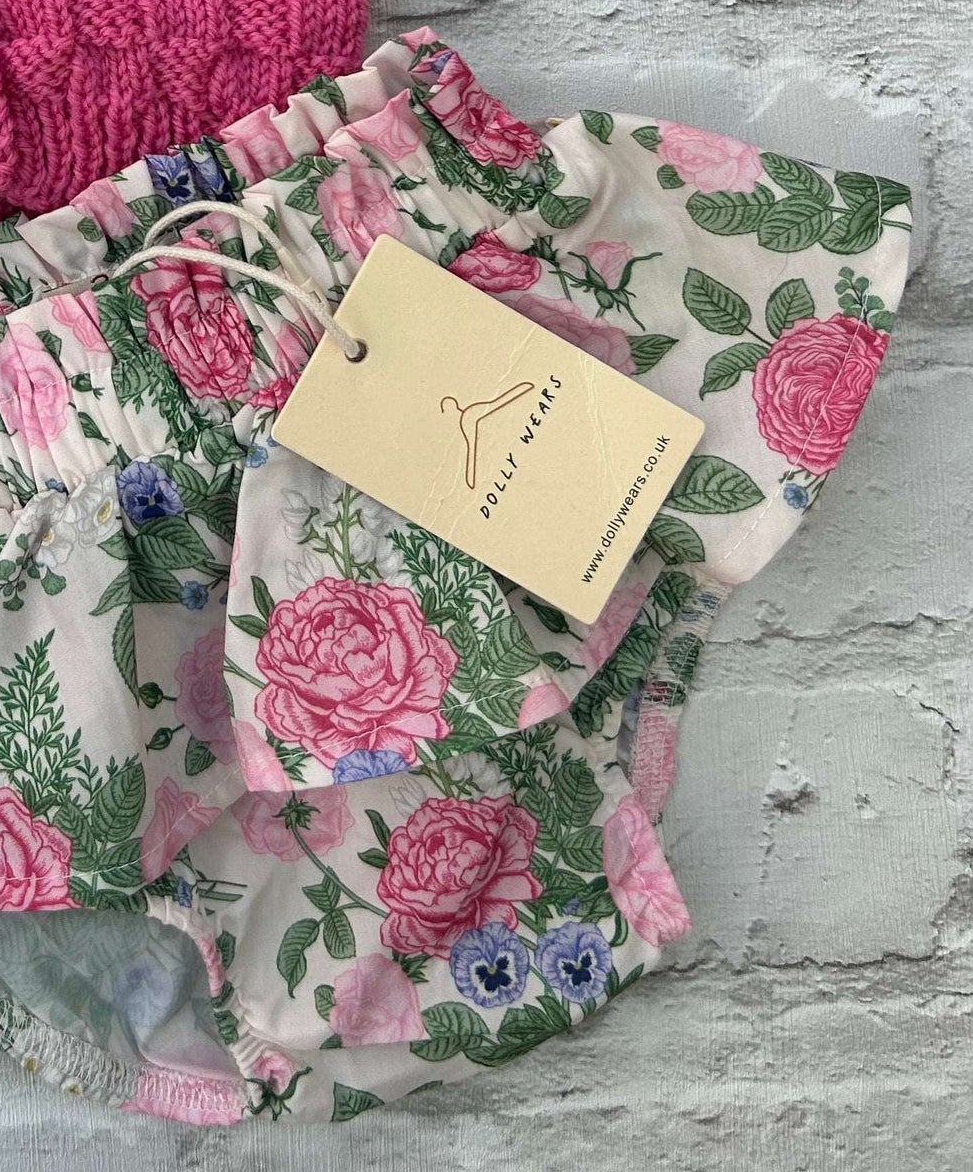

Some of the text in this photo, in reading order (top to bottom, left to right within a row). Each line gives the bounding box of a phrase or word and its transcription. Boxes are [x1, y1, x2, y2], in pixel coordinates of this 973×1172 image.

[480, 375, 562, 519] DOLLY WEARS
[580, 434, 671, 583] www.dollywears.co.uk
